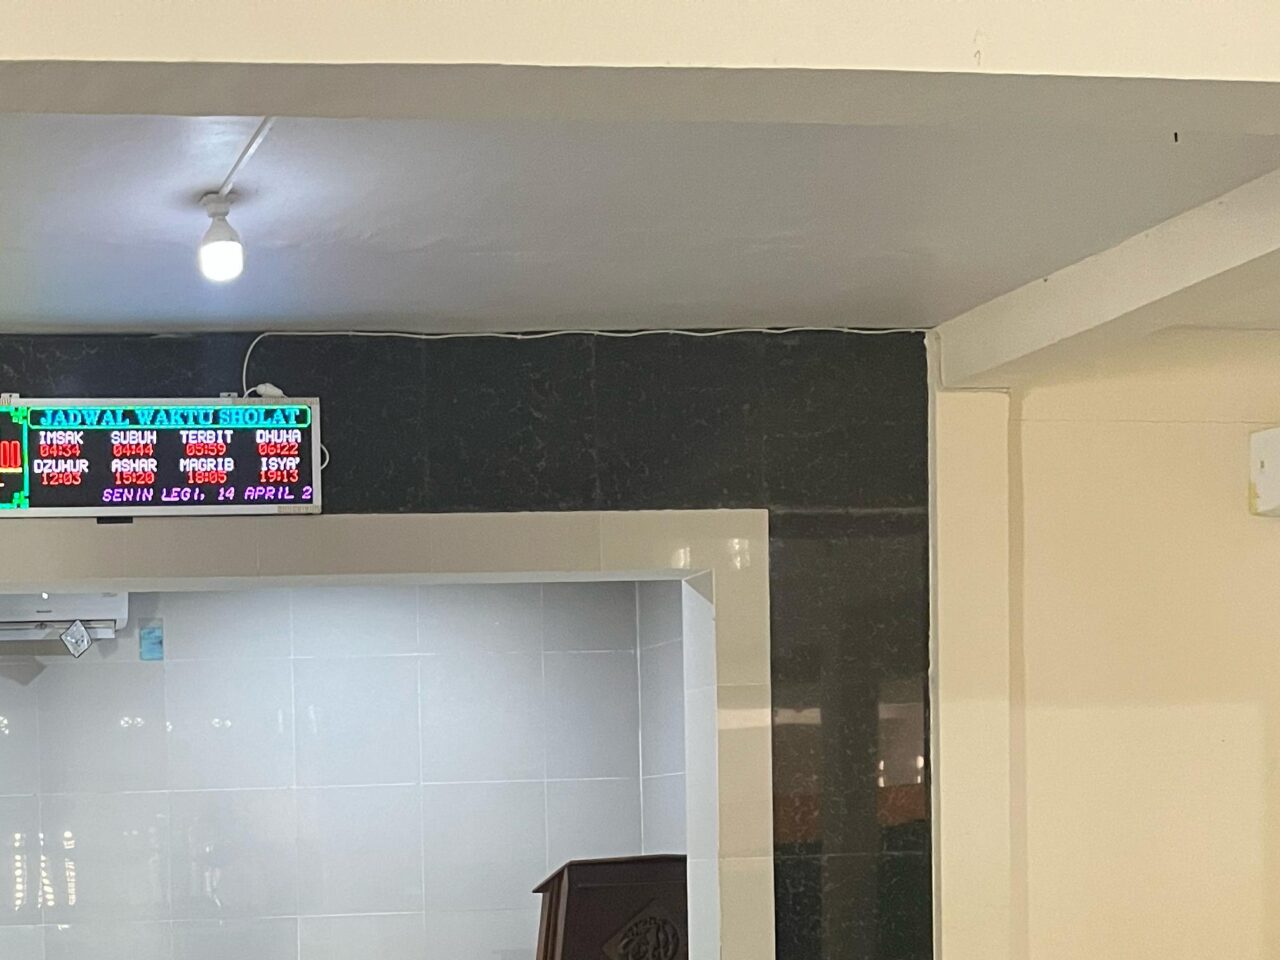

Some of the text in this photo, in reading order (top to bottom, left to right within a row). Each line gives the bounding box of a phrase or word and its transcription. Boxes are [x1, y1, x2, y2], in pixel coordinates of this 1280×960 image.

[40, 409, 299, 426] JADWAL WAKTU SHOLAT
[39, 431, 83, 444] IMSAK
[111, 431, 156, 444] SUBUH
[180, 430, 233, 443] TERBIT
[256, 430, 301, 443] DHUHA
[40, 444, 80, 457] 04:34
[113, 444, 153, 457] 04:44
[186, 443, 226, 456] 05:59
[259, 443, 298, 455] 06:22
[34, 459, 88, 472] DZUHUR
[111, 459, 157, 472] ASHAR
[180, 458, 234, 471] MAGRIB
[41, 472, 81, 485] 12:03
[115, 471, 154, 484] 15:20
[187, 471, 227, 483] 18:05
[260, 470, 298, 482] 19:13
[102, 488, 153, 502] SENIN
[218, 487, 234, 500] 14
[244, 487, 294, 500] APRIL
